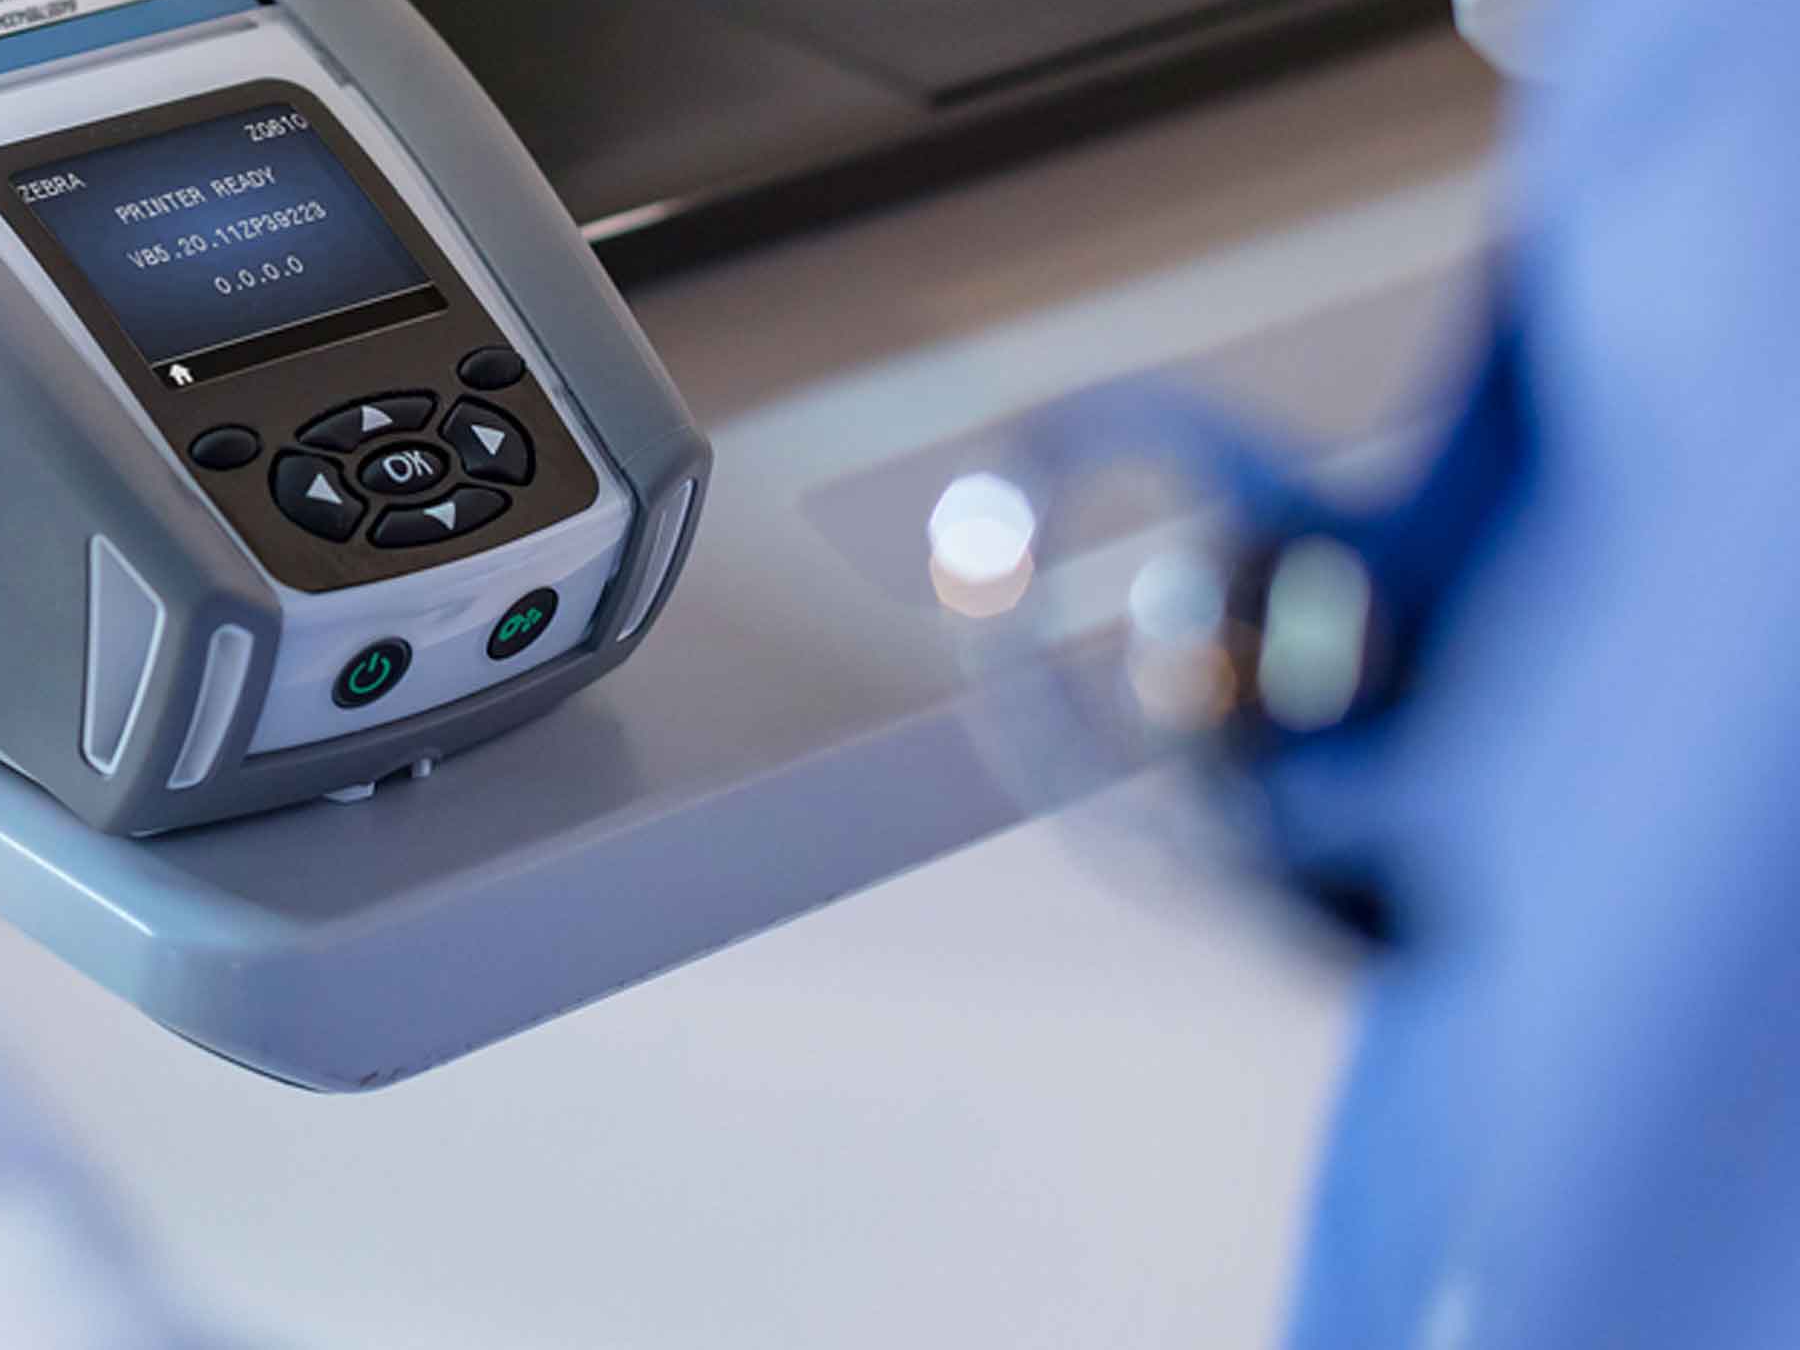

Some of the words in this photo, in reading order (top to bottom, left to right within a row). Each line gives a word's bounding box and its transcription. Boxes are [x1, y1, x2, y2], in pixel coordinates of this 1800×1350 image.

[16, 172, 86, 203] ZEBRA
[114, 185, 207, 225] PRINTER
[210, 166, 276, 199] READY
[214, 255, 303, 295] 0.0.0.0
[382, 450, 433, 483] OK
